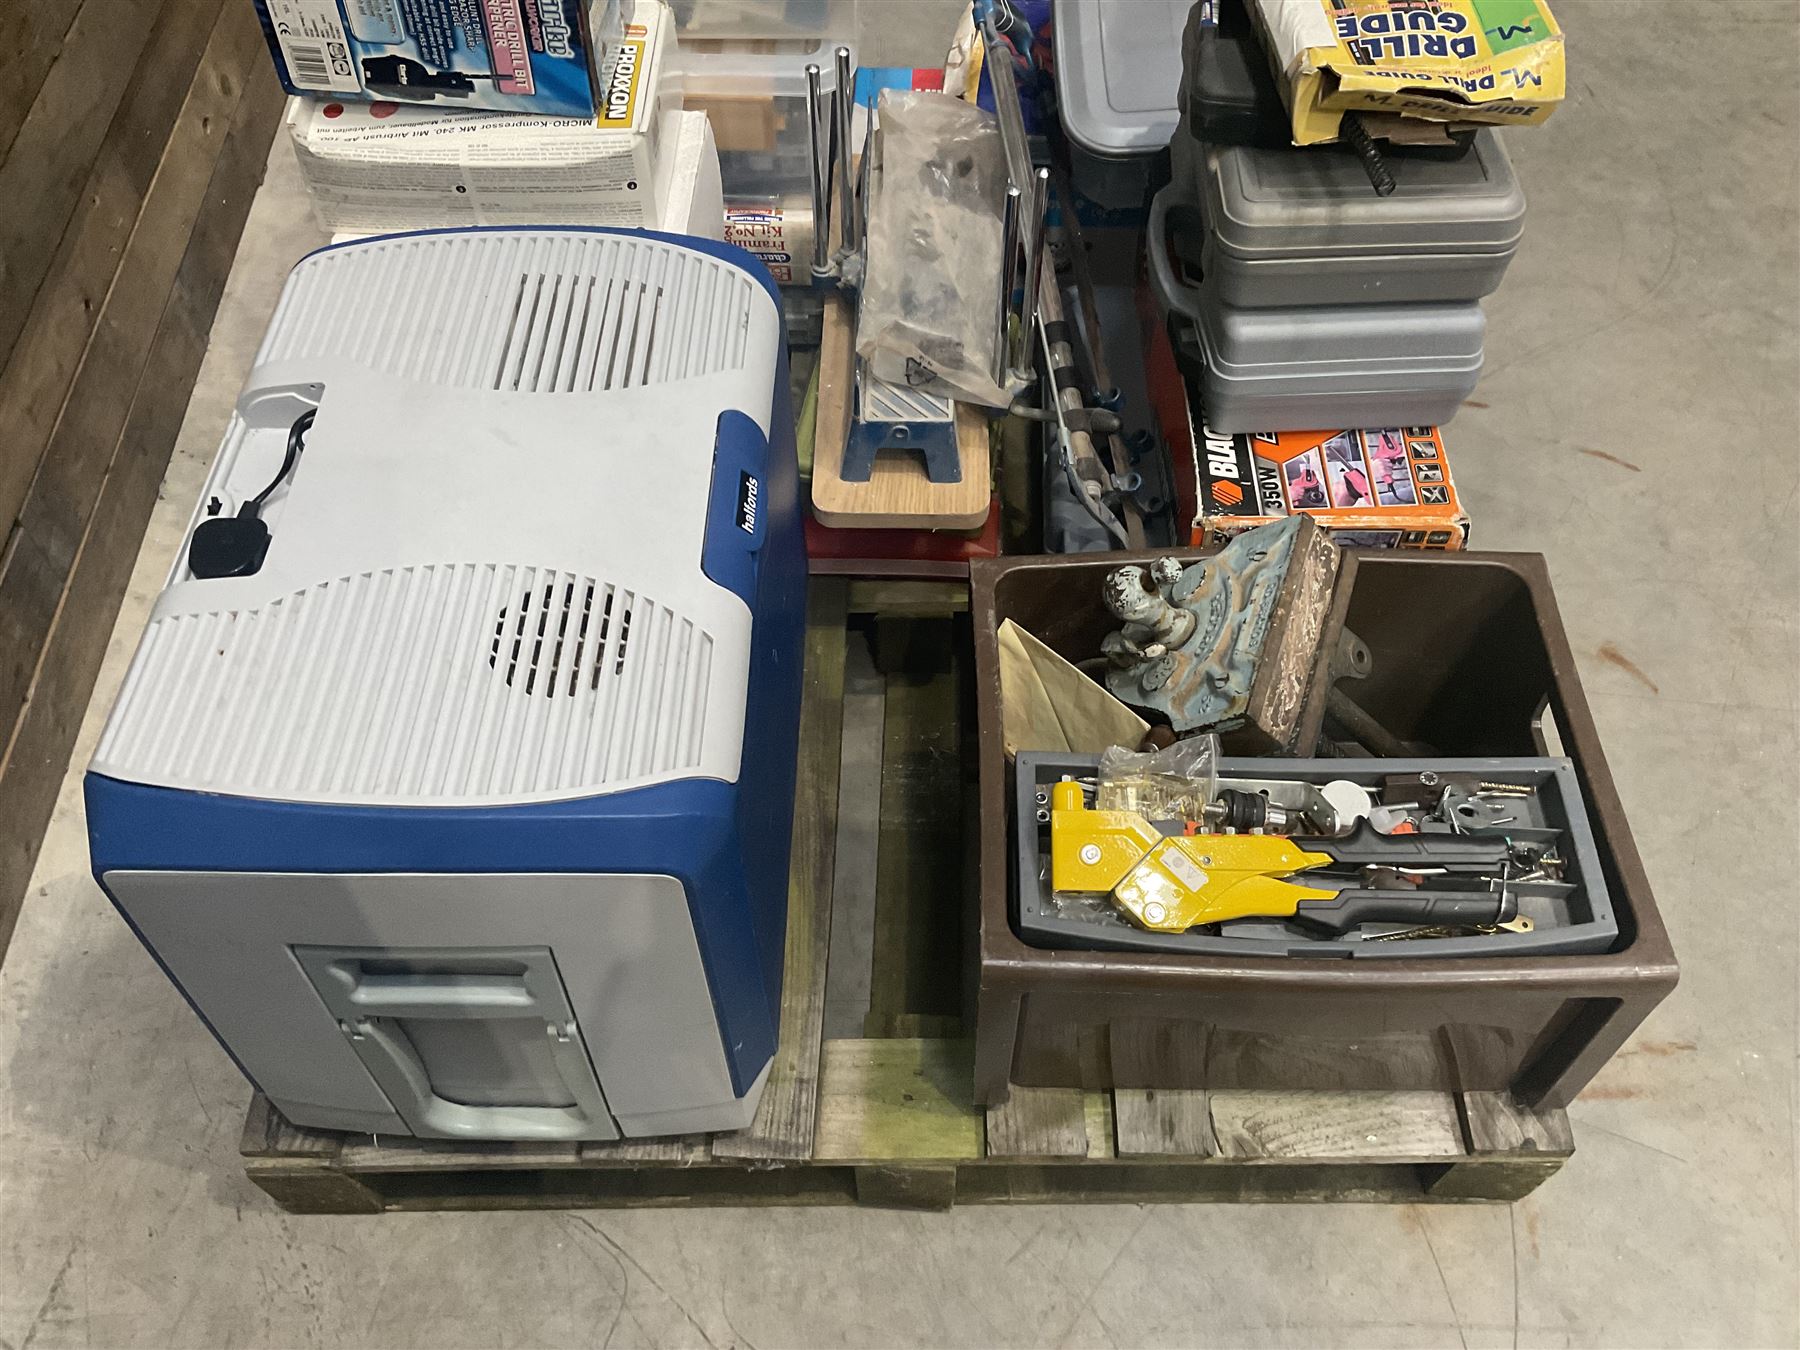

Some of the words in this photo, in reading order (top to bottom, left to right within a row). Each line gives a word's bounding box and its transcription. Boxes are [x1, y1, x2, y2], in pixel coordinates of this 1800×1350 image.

[450, 6, 462, 28] EDGE
[467, 0, 480, 22] LUNT
[472, 23, 483, 46] DRILL
[1335, 10, 1468, 39] GUIDE
[506, 31, 524, 67] DRILL
[1359, 34, 1477, 60] DRILL
[514, 68, 530, 91] BIT
[608, 44, 638, 119] PROXXON
[1363, 71, 1433, 81] GUIDE
[1466, 65, 1492, 78] Ideal
[1437, 74, 1495, 93] DRILL
[1480, 105, 1540, 116] UIDE
[362, 131, 410, 141] Airbrush
[412, 129, 430, 137] Mit
[459, 125, 477, 133] MK
[481, 119, 593, 131] MICRO-Kompressor
[761, 225, 783, 238] Kit
[1203, 423, 1240, 479] BLAC
[1258, 466, 1283, 509] 350W
[741, 476, 758, 535] halfords
